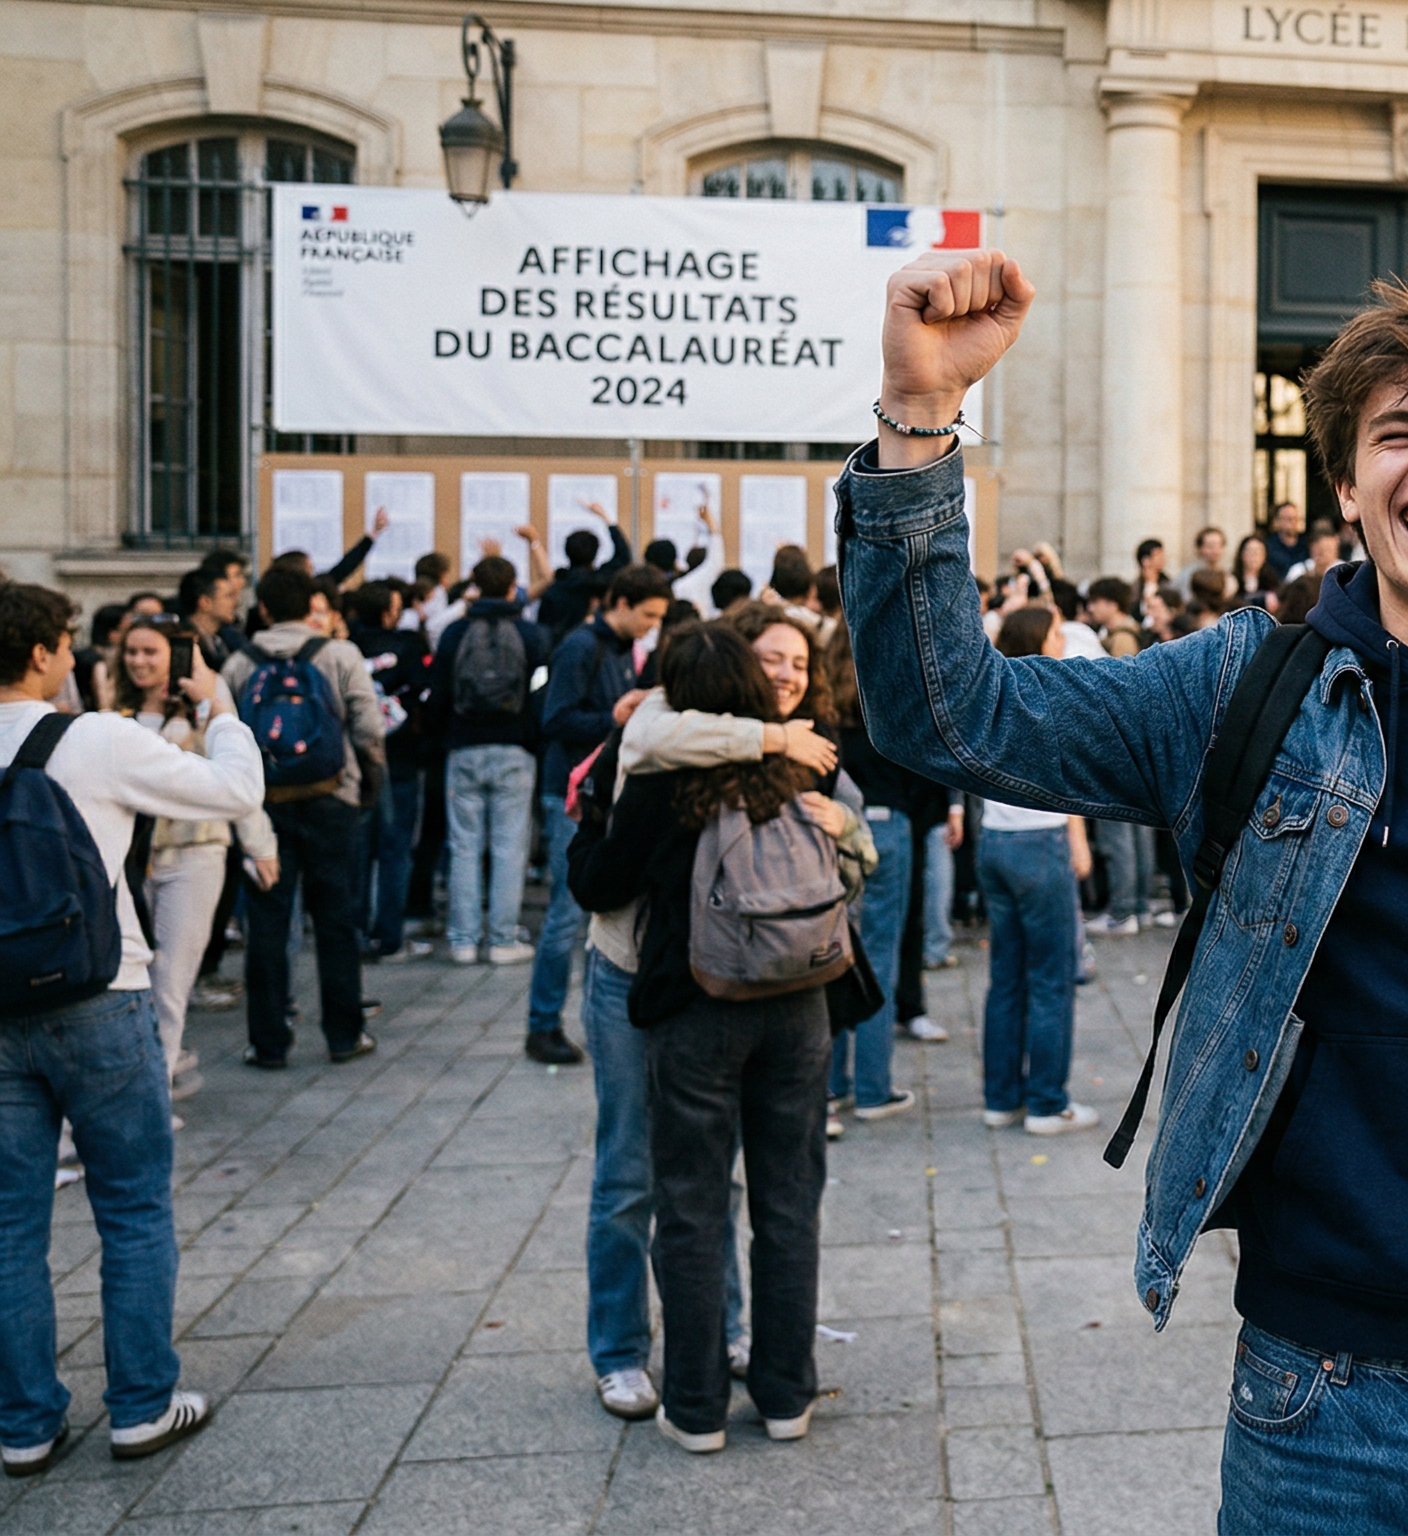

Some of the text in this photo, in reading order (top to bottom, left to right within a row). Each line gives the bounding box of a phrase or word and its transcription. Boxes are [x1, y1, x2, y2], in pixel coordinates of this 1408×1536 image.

[1243, 3, 1382, 48] LYCÉE
[518, 246, 760, 281] AFFICHAGE
[480, 284, 798, 325] DES RÉSULTATS
[433, 325, 844, 368] DU BACCALAURÉAT
[591, 375, 688, 406] 2024
